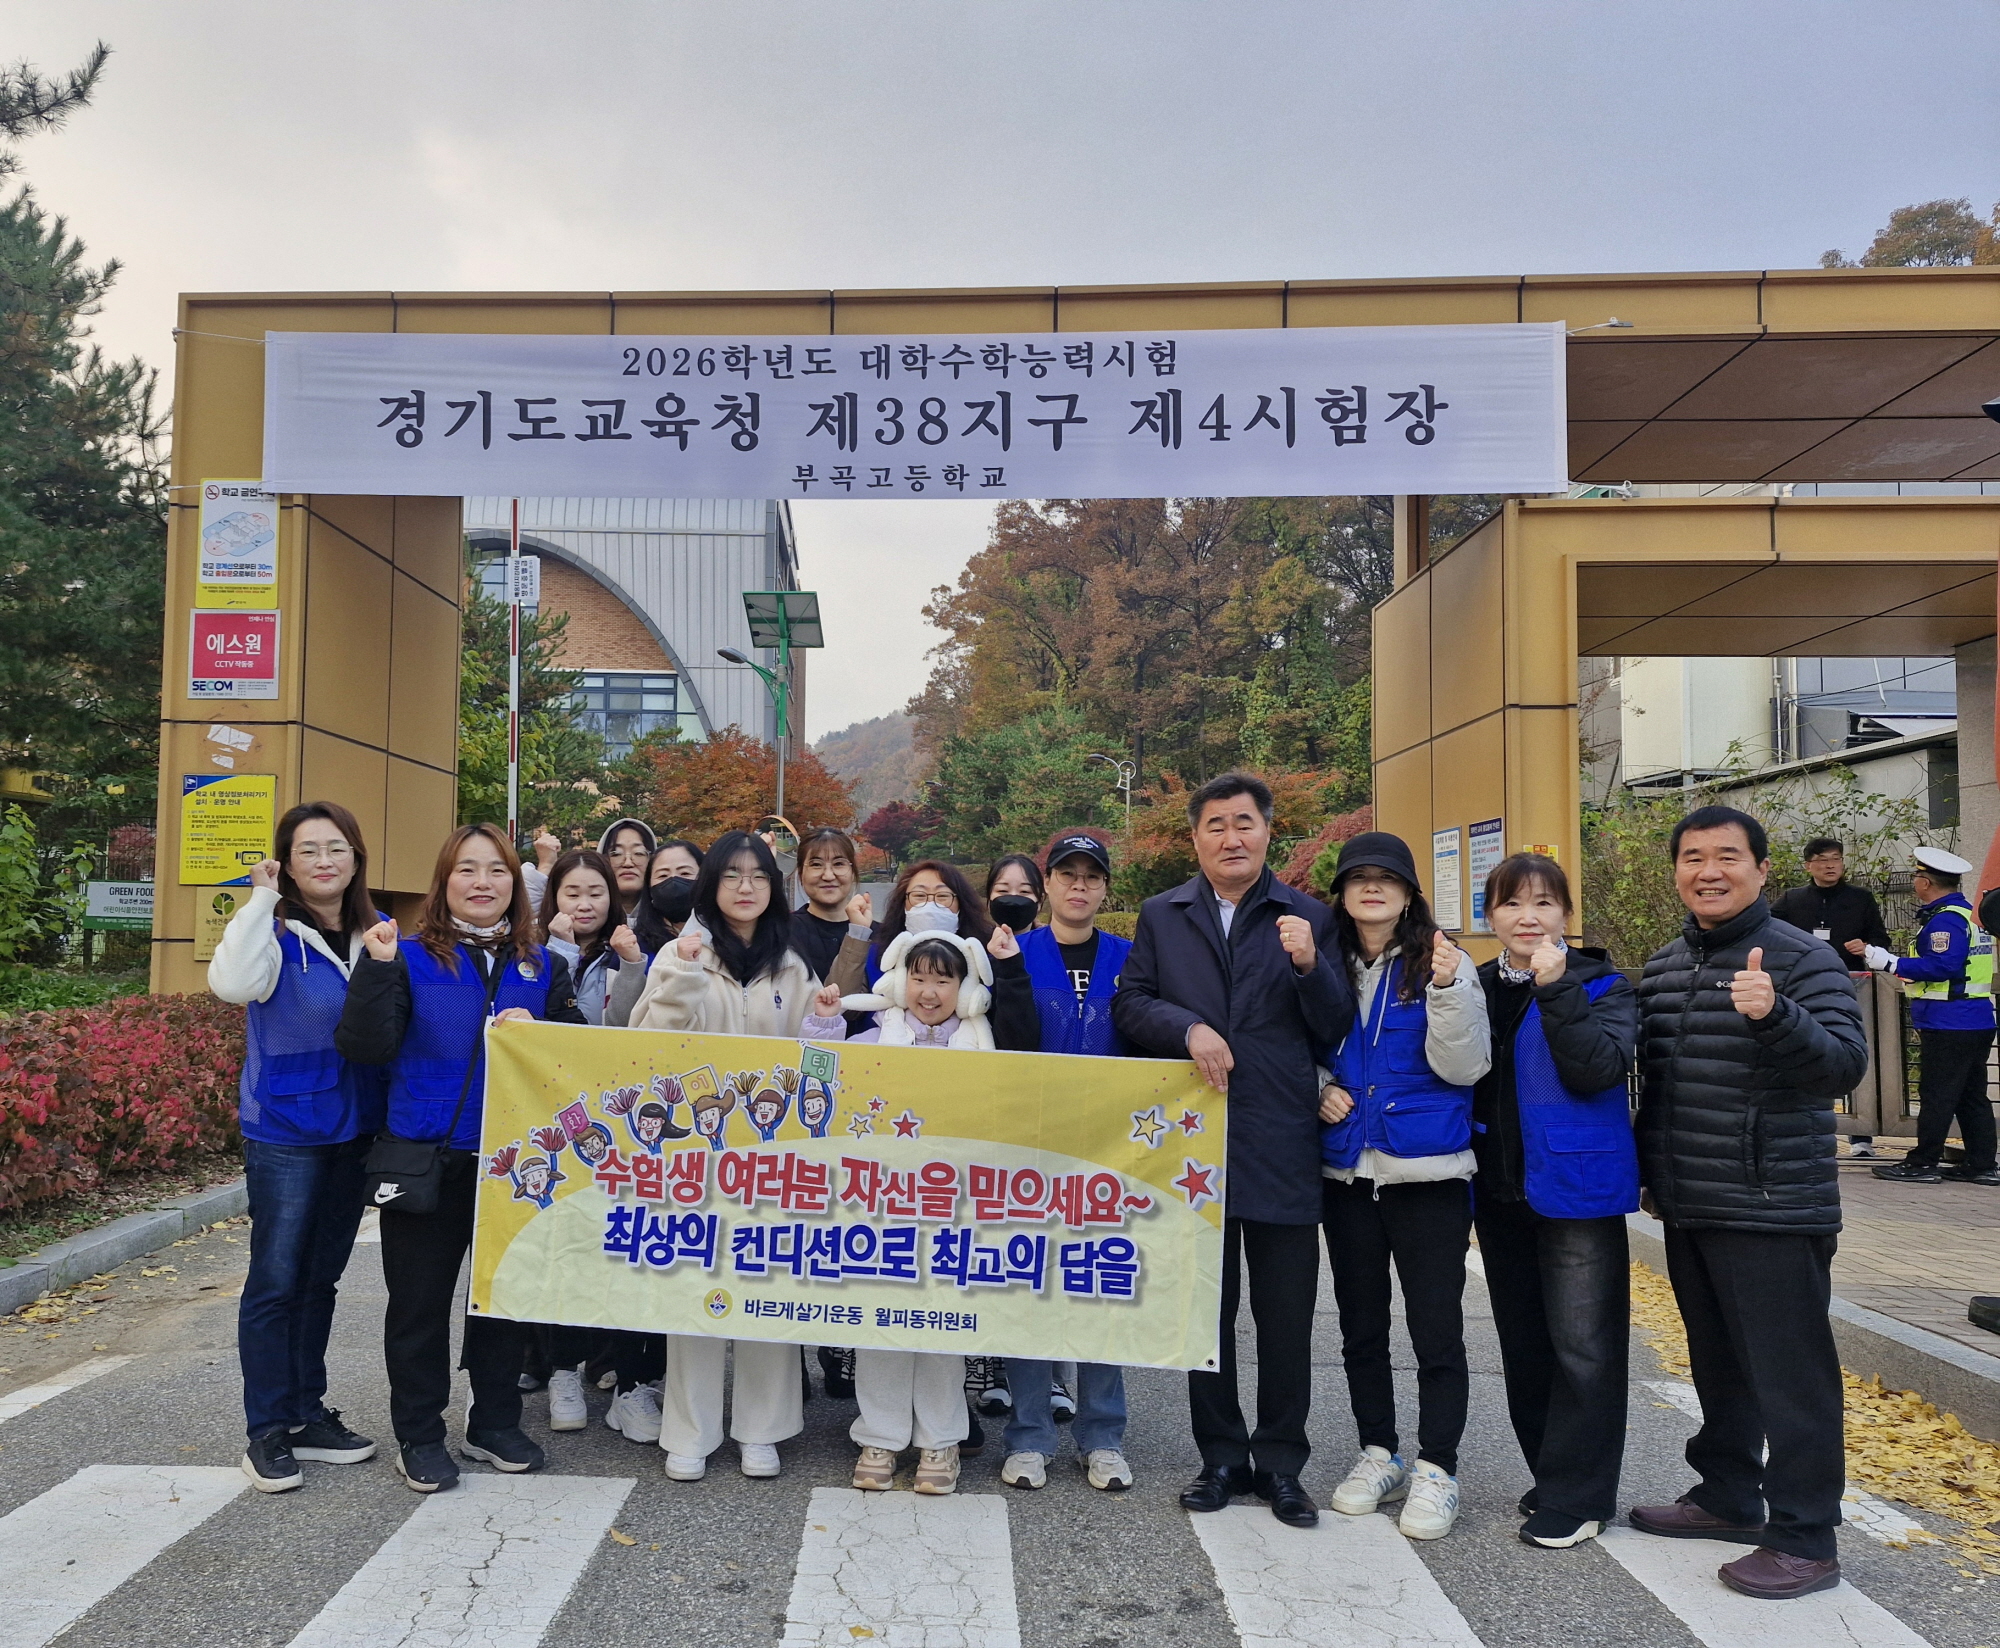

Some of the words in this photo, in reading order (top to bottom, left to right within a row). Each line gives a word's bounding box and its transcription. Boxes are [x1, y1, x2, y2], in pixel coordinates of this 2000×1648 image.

[624, 346, 837, 381] 2026학년도
[861, 341, 1176, 381] 대학수학능력시험
[378, 391, 760, 452] 경기도교육청
[808, 392, 1088, 453] 제38지구
[1130, 386, 1449, 450] 제4시험장
[793, 465, 1007, 493] 부곡고등학교
[221, 487, 239, 497] 학교
[206, 633, 261, 655] 에스원
[192, 680, 233, 691] SECOM
[109, 887, 133, 896] GREEN
[567, 1115, 583, 1131] 화
[379, 1182, 399, 1195] NIKE
[595, 1149, 705, 1204] 수험생
[717, 1151, 829, 1210] 여러분
[840, 1156, 958, 1218] 자신을
[969, 1164, 1152, 1227] 믿으세요~
[604, 1206, 717, 1268] 최상의
[731, 1223, 917, 1278] 컨디션으로
[931, 1228, 1047, 1290] 최고의
[1060, 1237, 1137, 1296] 답을
[744, 1299, 864, 1326] 바르게살기운동
[874, 1307, 978, 1333] 월피동위원회
